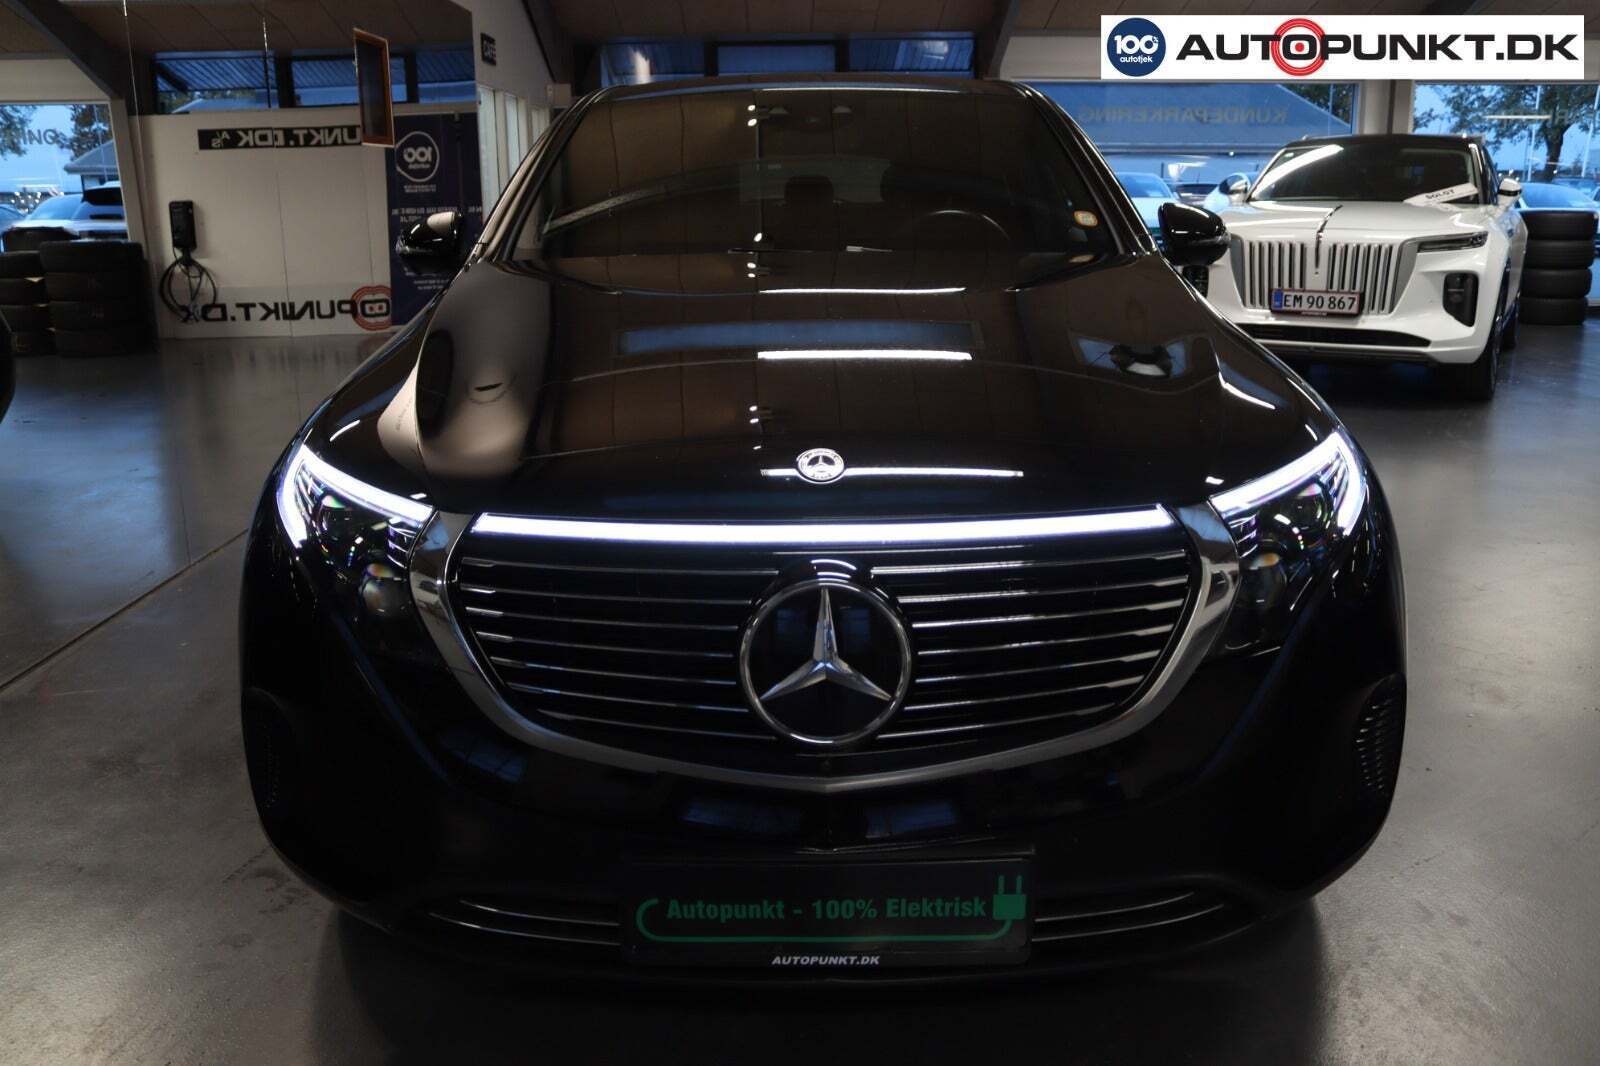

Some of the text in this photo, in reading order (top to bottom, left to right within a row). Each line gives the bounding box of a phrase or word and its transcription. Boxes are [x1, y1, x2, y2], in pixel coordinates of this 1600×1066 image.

[1283, 294, 1356, 310] EM 90 867
[667, 898, 786, 923] Autopunkt
[812, 898, 878, 920] 100%
[886, 897, 987, 918] Elektrisk
[771, 955, 881, 967] AUTOPUNKT.DK
